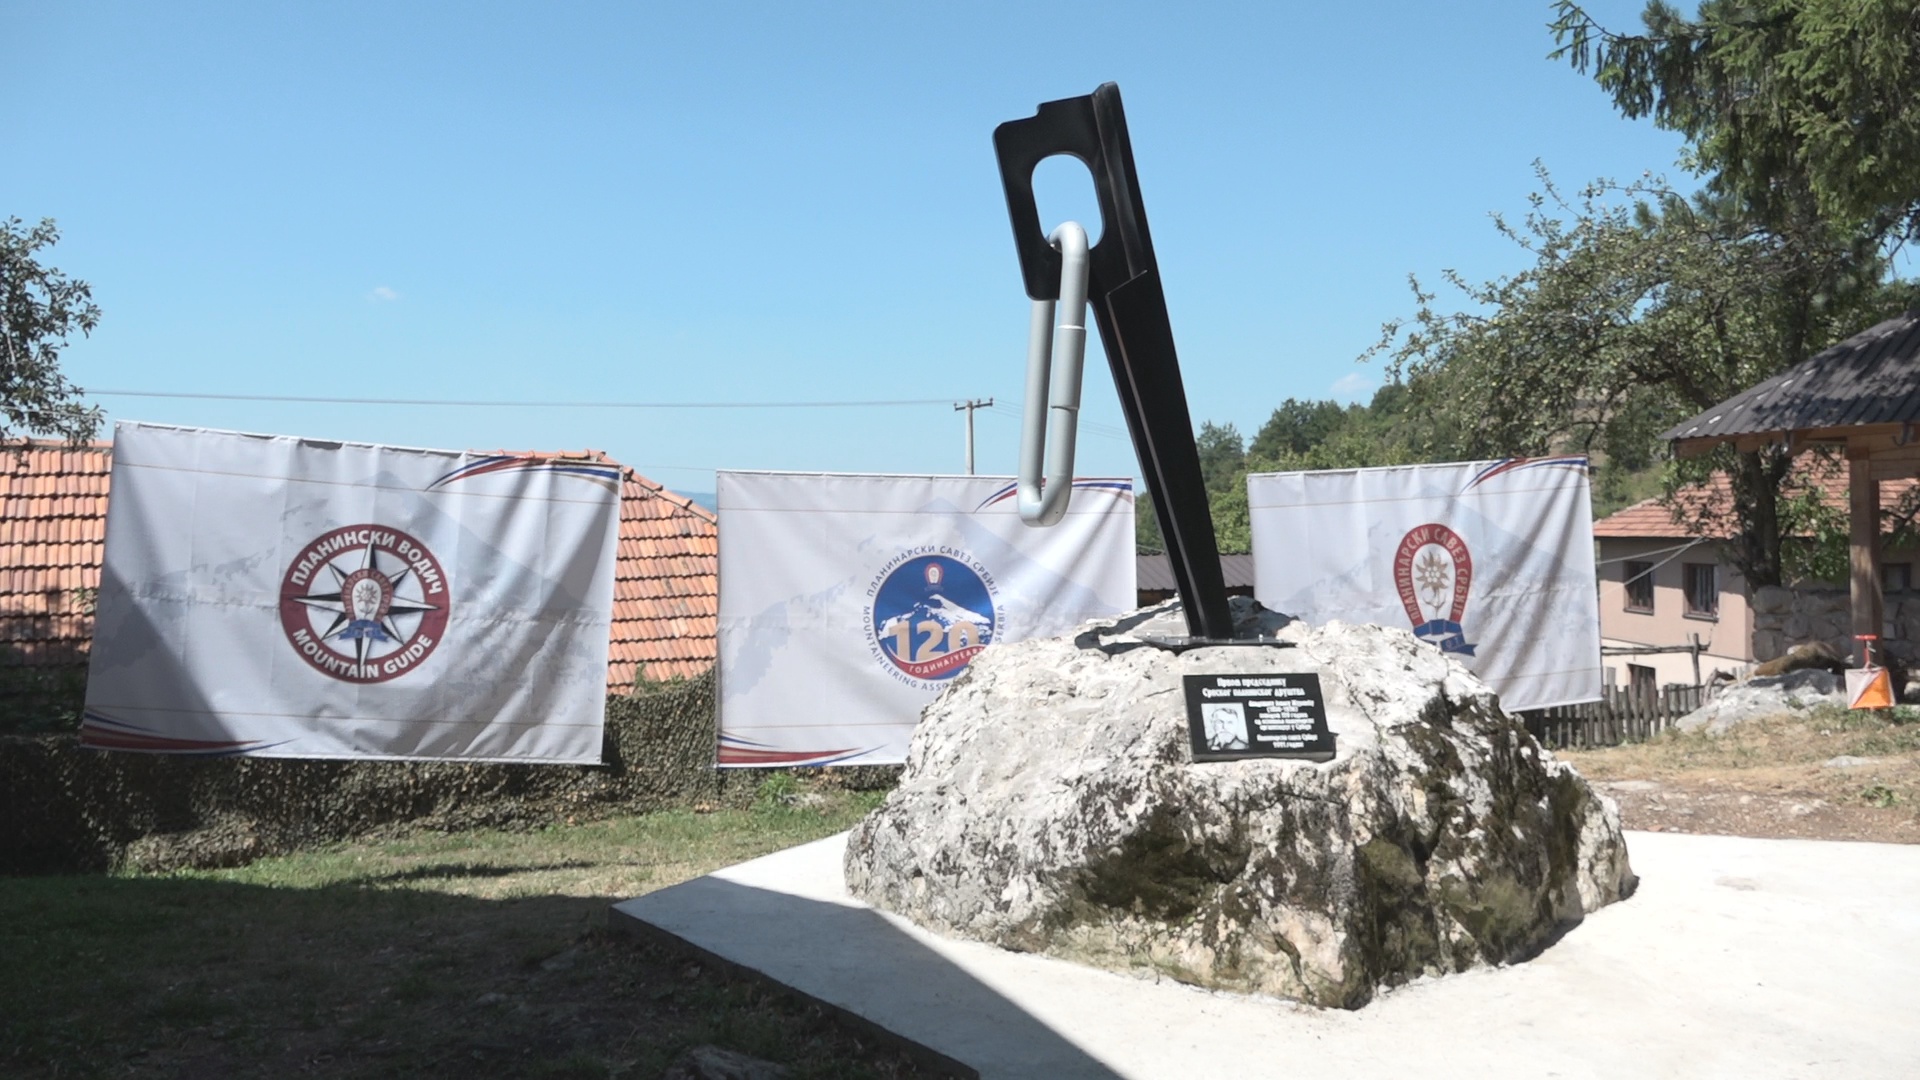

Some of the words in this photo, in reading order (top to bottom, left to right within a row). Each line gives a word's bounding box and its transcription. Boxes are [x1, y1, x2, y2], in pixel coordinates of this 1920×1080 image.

[291, 530, 396, 586] ПЛАНИНСКИ
[397, 540, 443, 594] ВОДИЧ
[866, 545, 936, 598] ПЛАНИНАРСКИ
[939, 545, 972, 563] САВЕЗ
[973, 562, 1000, 597] СРБИЈЕ
[1397, 528, 1431, 620] ПЛАНИНАРСКИ
[1434, 528, 1466, 563] САВЕЗ
[1452, 568, 1468, 615] СРБИЈЕ
[293, 628, 379, 679] MOUNTAIN
[383, 634, 432, 675] GUIDE
[863, 606, 918, 689] MOUNTAINEERING
[889, 620, 980, 662] 120
